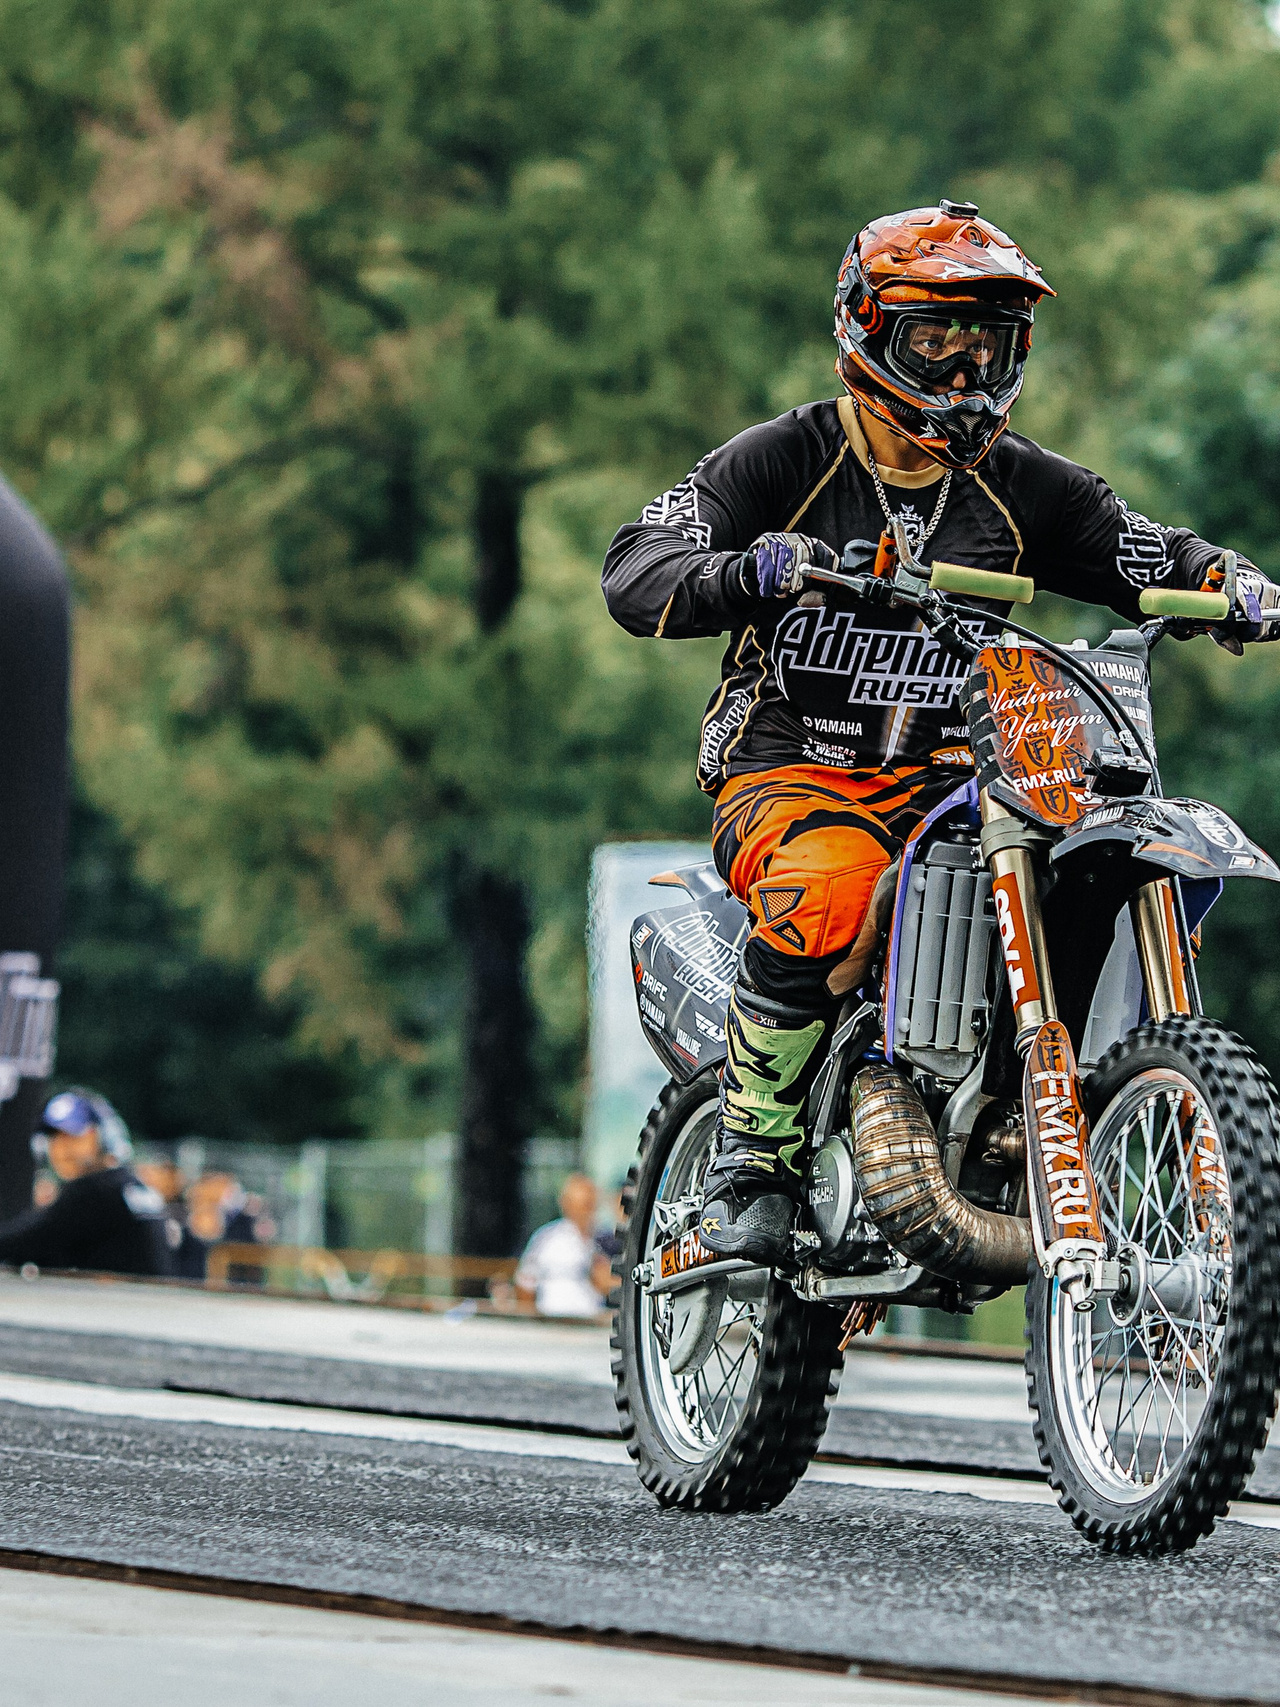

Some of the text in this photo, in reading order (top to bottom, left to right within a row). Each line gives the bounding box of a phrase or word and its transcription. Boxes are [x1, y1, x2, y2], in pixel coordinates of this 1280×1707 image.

[1089, 661, 1142, 685] YAMAHA
[849, 676, 958, 708] RUSH
[813, 717, 863, 736] YAMAHA
[1001, 708, 1105, 758] Yarygin
[1012, 767, 1077, 794] FMX.RU
[673, 960, 726, 1005] RUSH
[1031, 1070, 1093, 1226] FMX.RU
